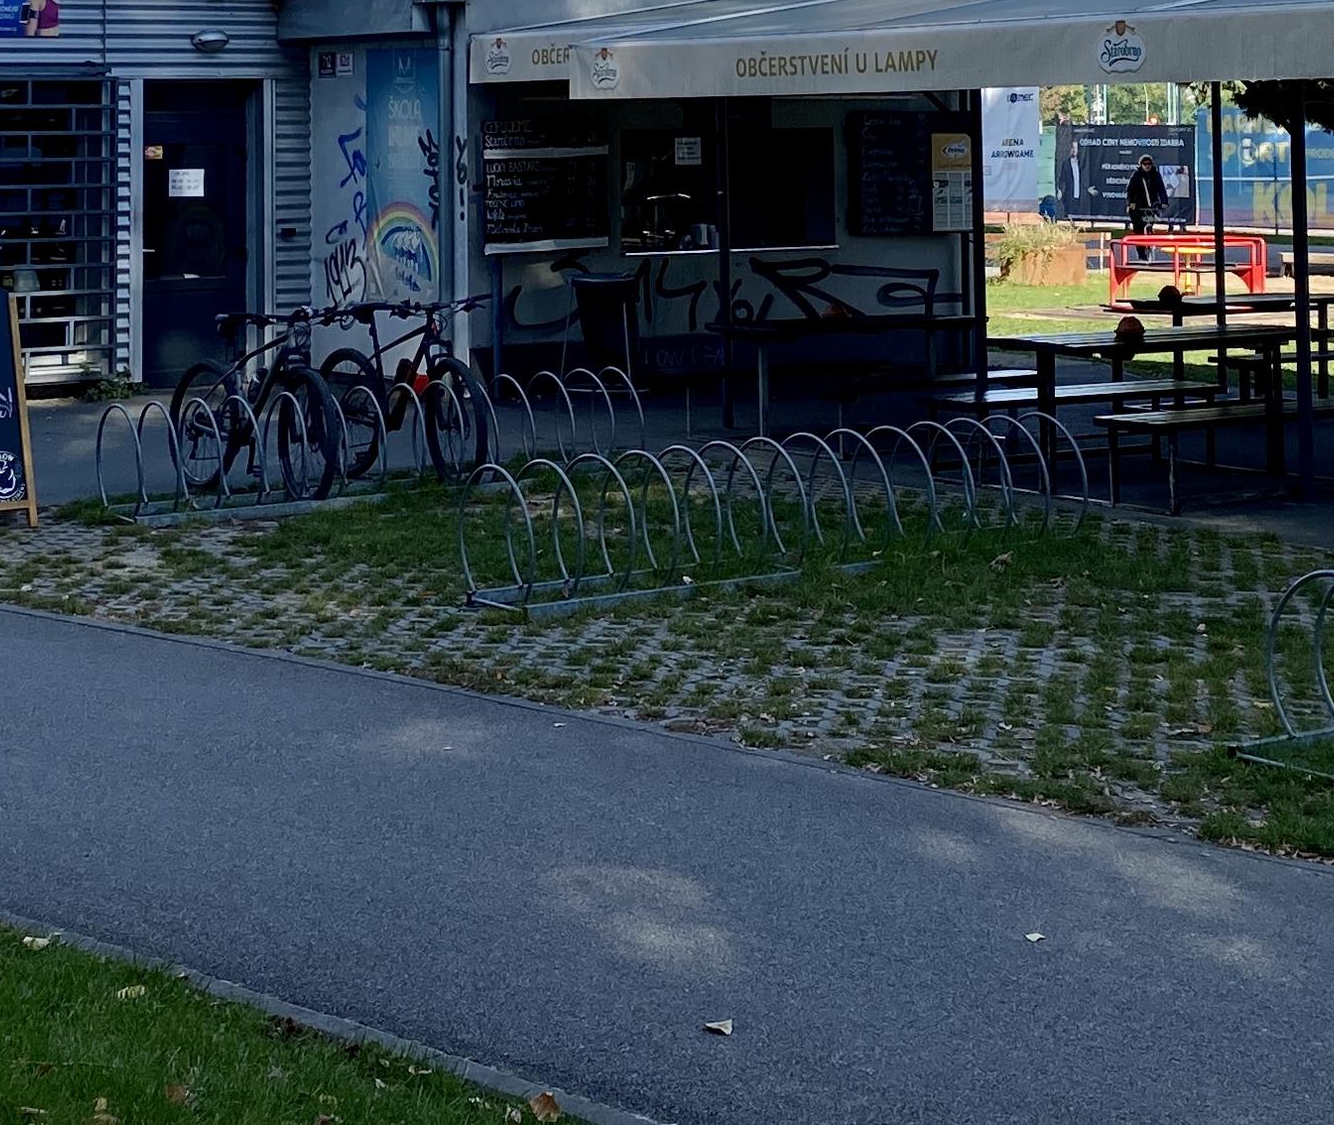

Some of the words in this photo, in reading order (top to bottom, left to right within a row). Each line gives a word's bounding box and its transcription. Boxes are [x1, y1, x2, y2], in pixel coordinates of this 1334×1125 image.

[735, 47, 849, 78] OBČERSTVENÍ
[856, 53, 867, 73] U
[875, 49, 938, 73] LAMPY
